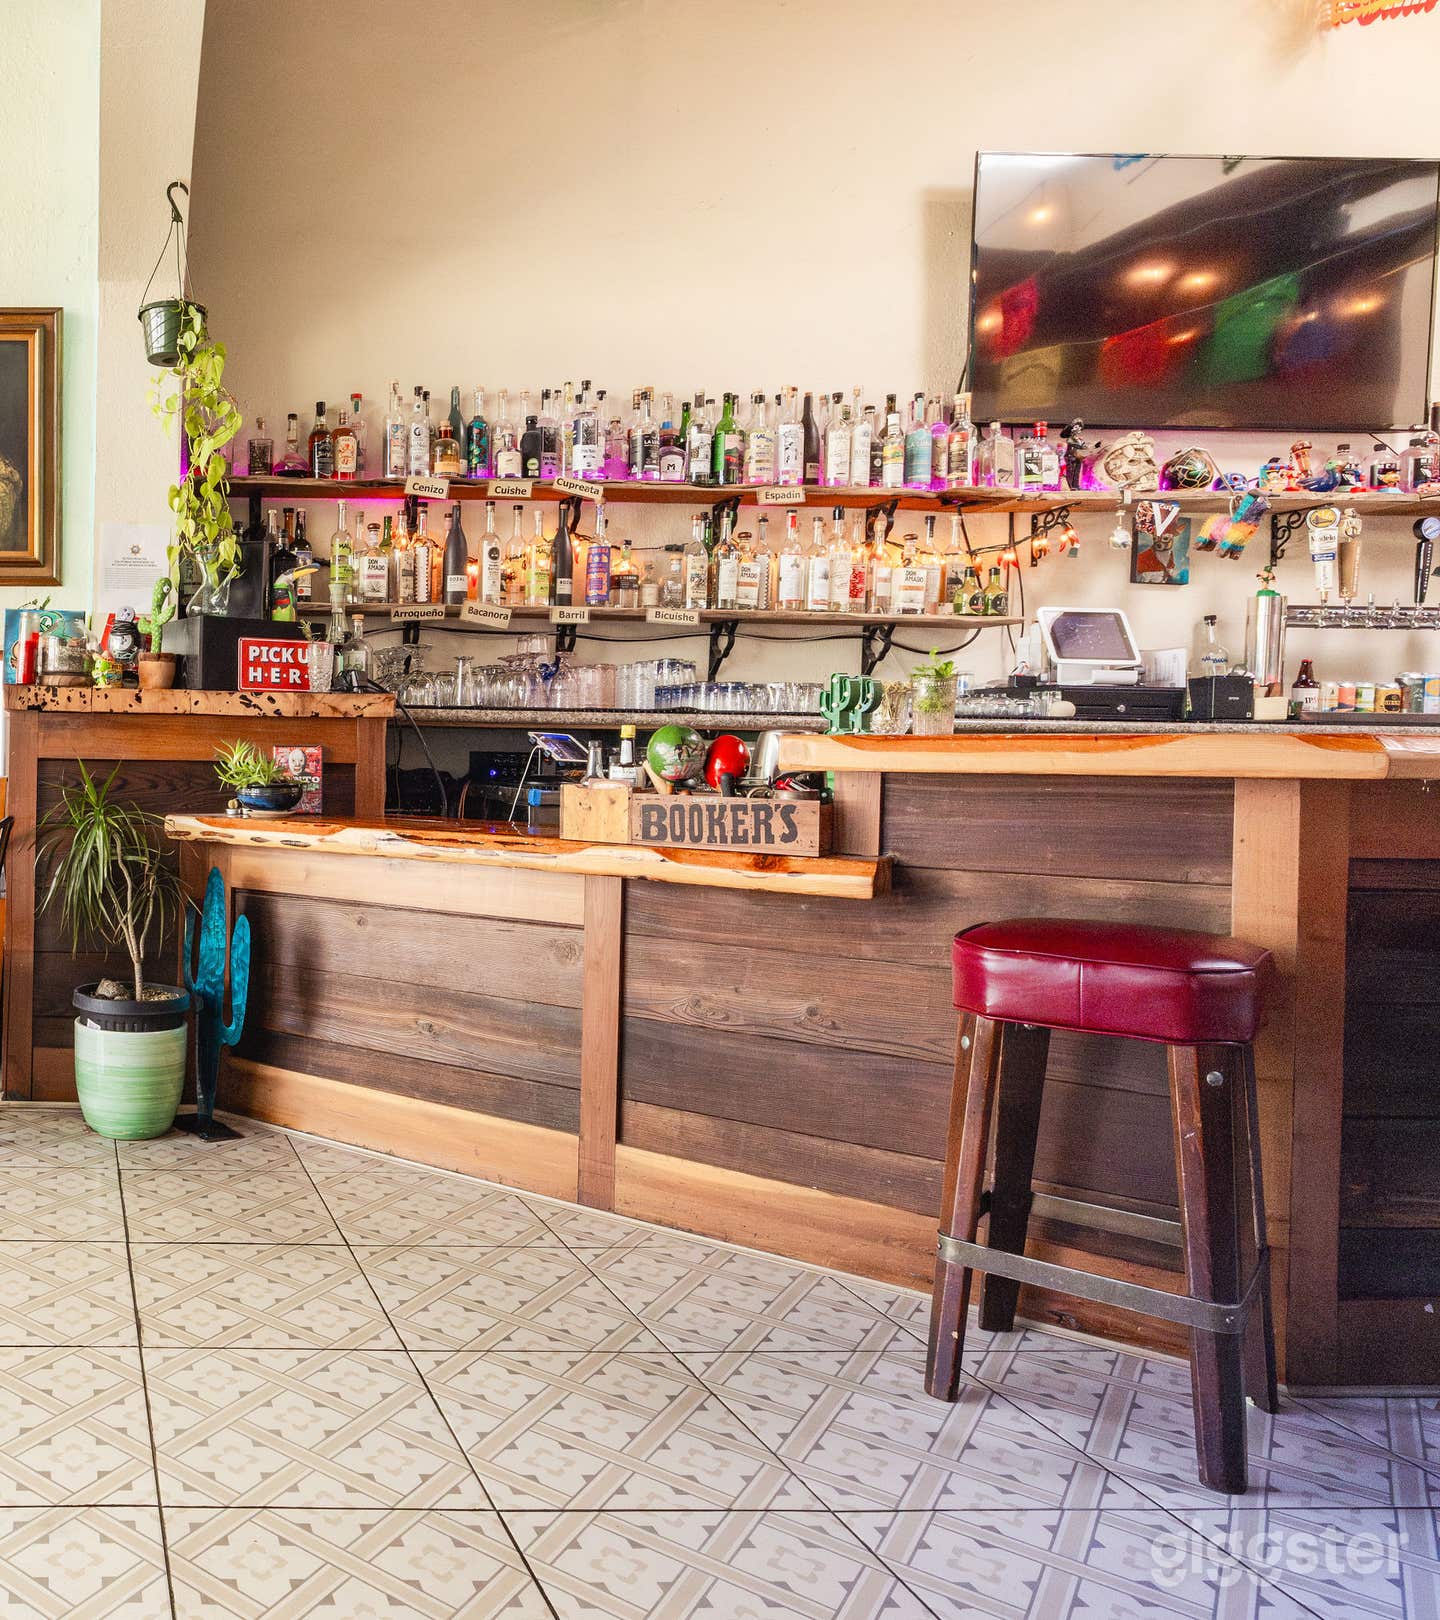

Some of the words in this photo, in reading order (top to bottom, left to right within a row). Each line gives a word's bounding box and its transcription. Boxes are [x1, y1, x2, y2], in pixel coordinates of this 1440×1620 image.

[412, 482, 444, 495] Cenizo
[494, 485, 527, 496] Cuishe
[556, 477, 600, 495] Cupreata
[393, 608, 444, 618] Arroqueño
[467, 606, 509, 620] Bacanora
[559, 610, 585, 619] Barril
[655, 611, 695, 622] Bicuishe
[248, 645, 295, 664] PICK
[641, 803, 799, 845] BOOKER'S
